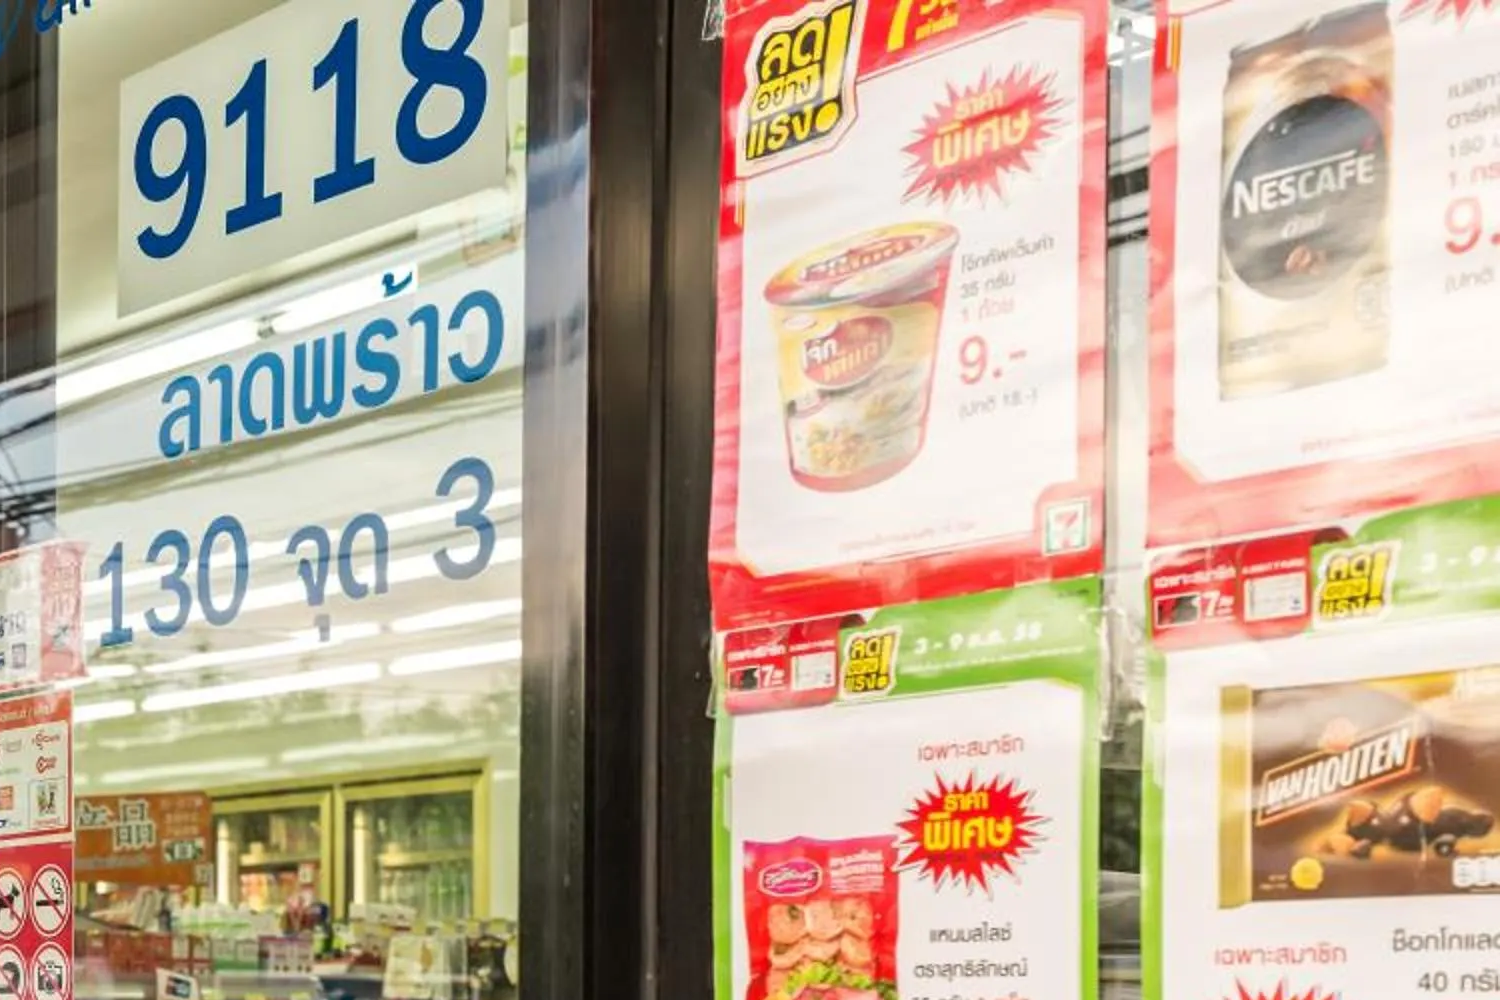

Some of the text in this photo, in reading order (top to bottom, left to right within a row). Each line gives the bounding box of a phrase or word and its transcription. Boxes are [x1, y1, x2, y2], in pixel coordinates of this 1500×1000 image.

[760, 18, 826, 82] ลด
[134, 0, 487, 259] 9118
[933, 108, 1031, 168] พิเศษ
[158, 271, 505, 460] ลาดพร้าว
[959, 335, 1027, 385] 9.-
[99, 514, 249, 647] 130
[286, 512, 389, 642] จุด
[433, 457, 495, 580] 3
[1302, 727, 1410, 802] HOUTEN
[924, 811, 1013, 851] พิเศษ
[944, 791, 989, 812] ราคา
[1214, 942, 1348, 966] เฉพาะสมาชิก
[1417, 971, 1449, 992] 40
